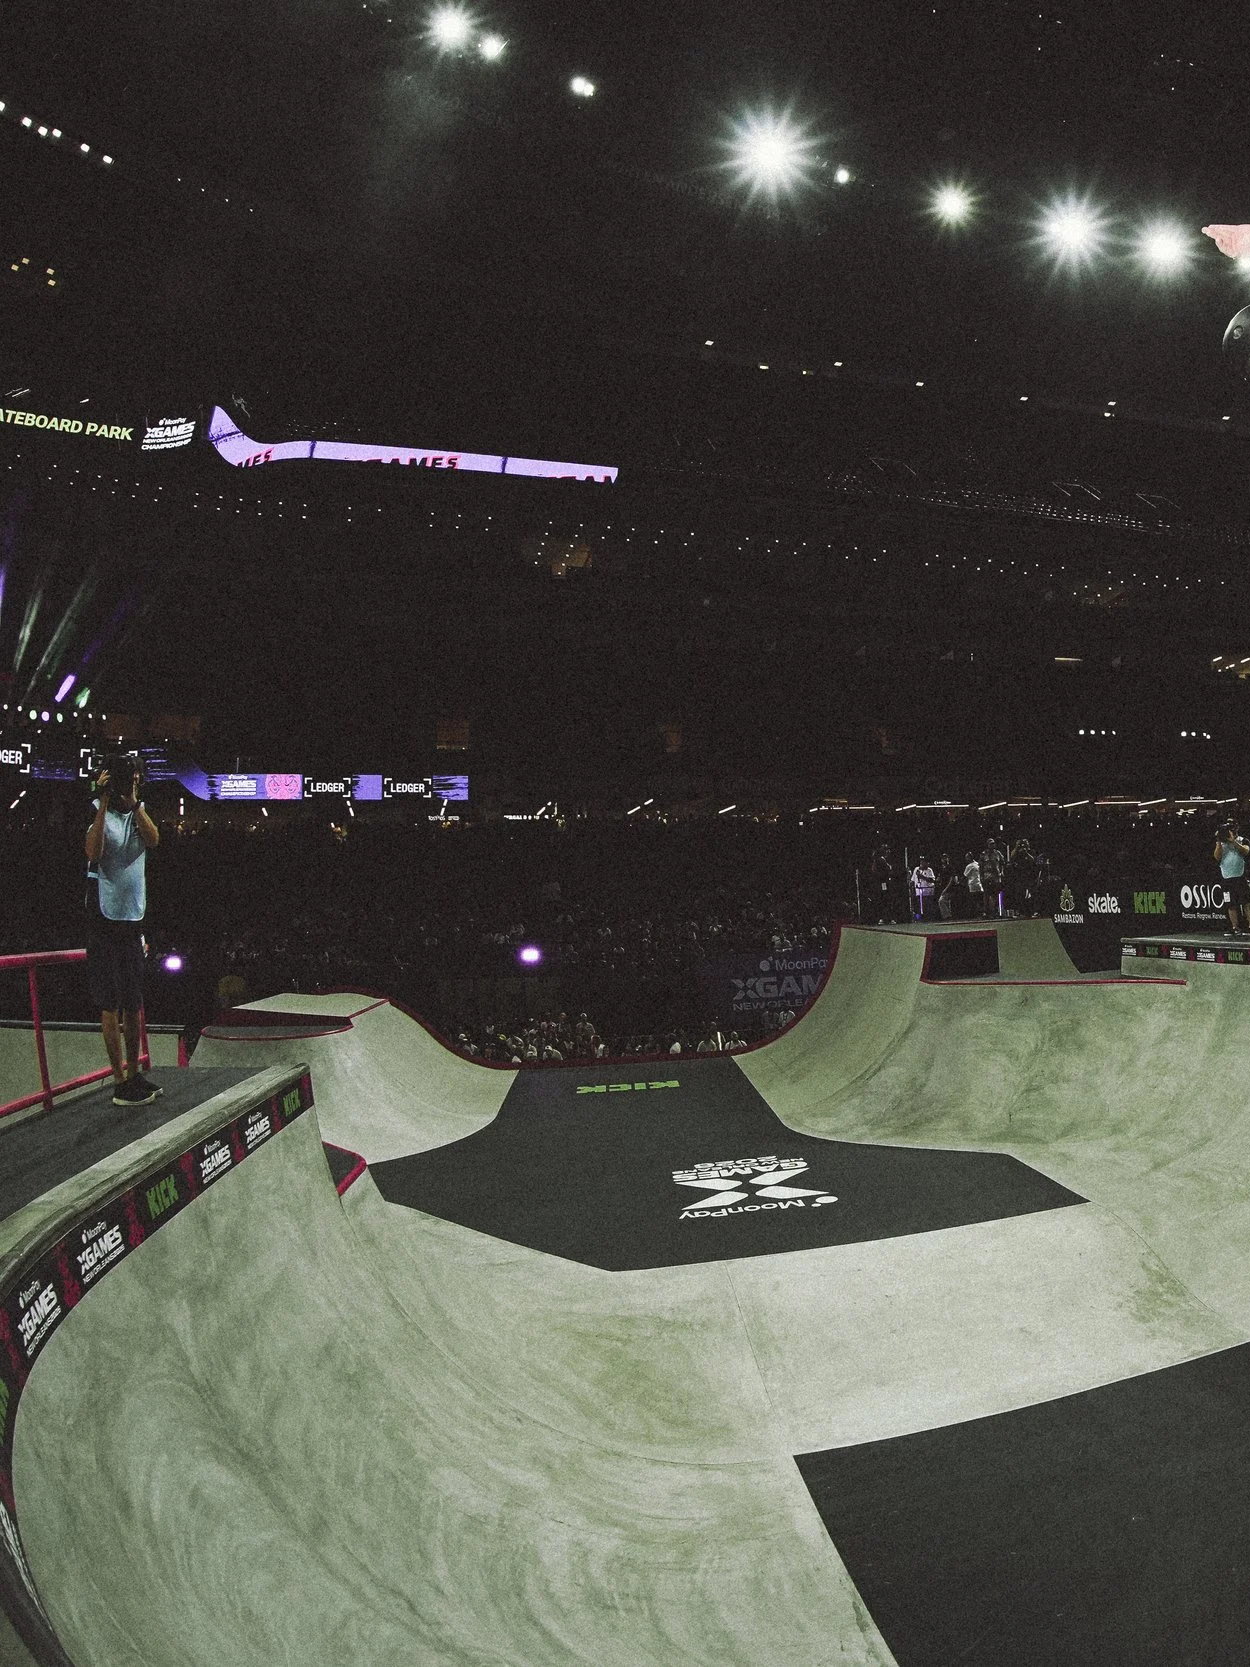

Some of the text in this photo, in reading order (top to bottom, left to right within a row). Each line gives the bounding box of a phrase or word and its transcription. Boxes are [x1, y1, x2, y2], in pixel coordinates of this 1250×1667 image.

[85, 422, 134, 441] PARK
[144, 421, 196, 439] XGAMES
[310, 783, 345, 793] LEDGER
[390, 783, 425, 793] LEDGER
[1088, 893, 1121, 914] skate.
[1134, 891, 1167, 914] KICK
[1054, 913, 1084, 924] SAMBAZON
[1228, 952, 1244, 962] KICK
[730, 974, 824, 1000] XGAM
[245, 1115, 270, 1144] XGAMES
[200, 1144, 231, 1178] XGAMES
[672, 1161, 808, 1182] GAMES
[146, 1174, 179, 1219] KICK
[679, 1200, 805, 1219] MoonPay
[76, 1224, 122, 1276] XGAMES
[17, 1282, 58, 1347] XGAMES
